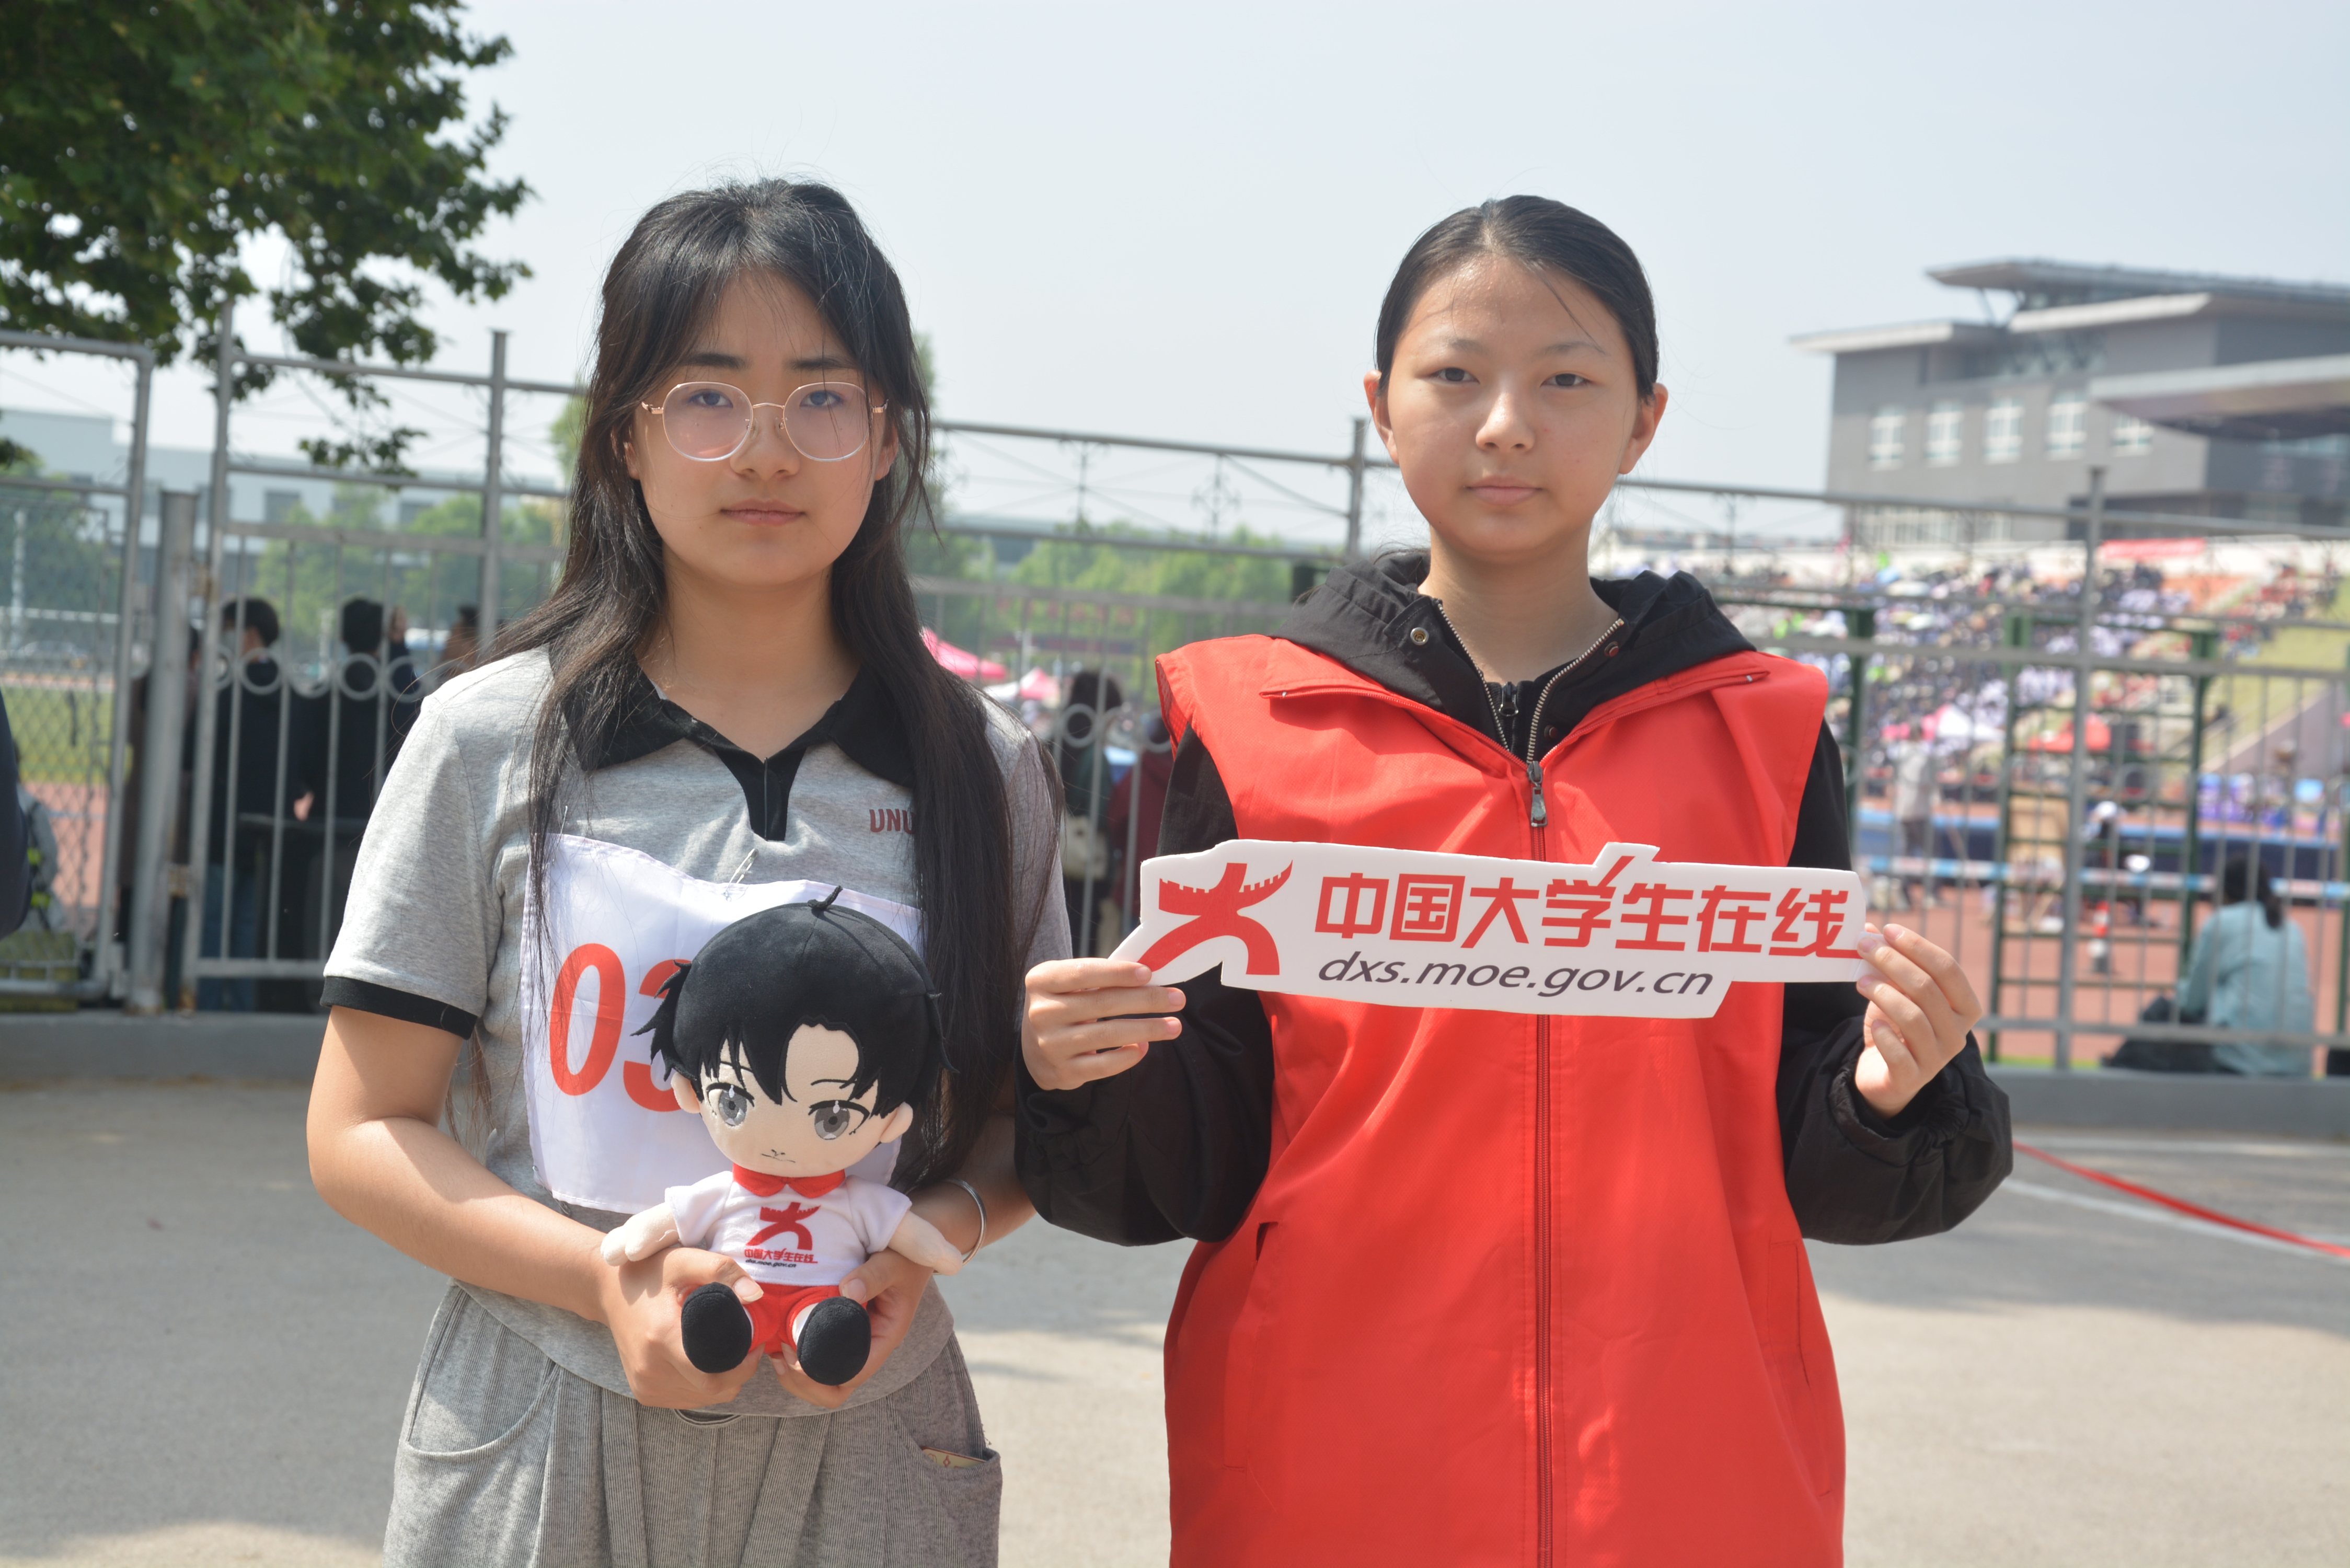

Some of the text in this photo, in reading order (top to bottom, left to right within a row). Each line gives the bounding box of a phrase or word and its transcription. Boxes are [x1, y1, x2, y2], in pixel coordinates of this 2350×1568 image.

[1314, 855, 1864, 960] 中国大学生在线
[1318, 951, 1714, 997] dxs.moe.gov.cn
[744, 1248, 819, 1264] 中国大学生在线
